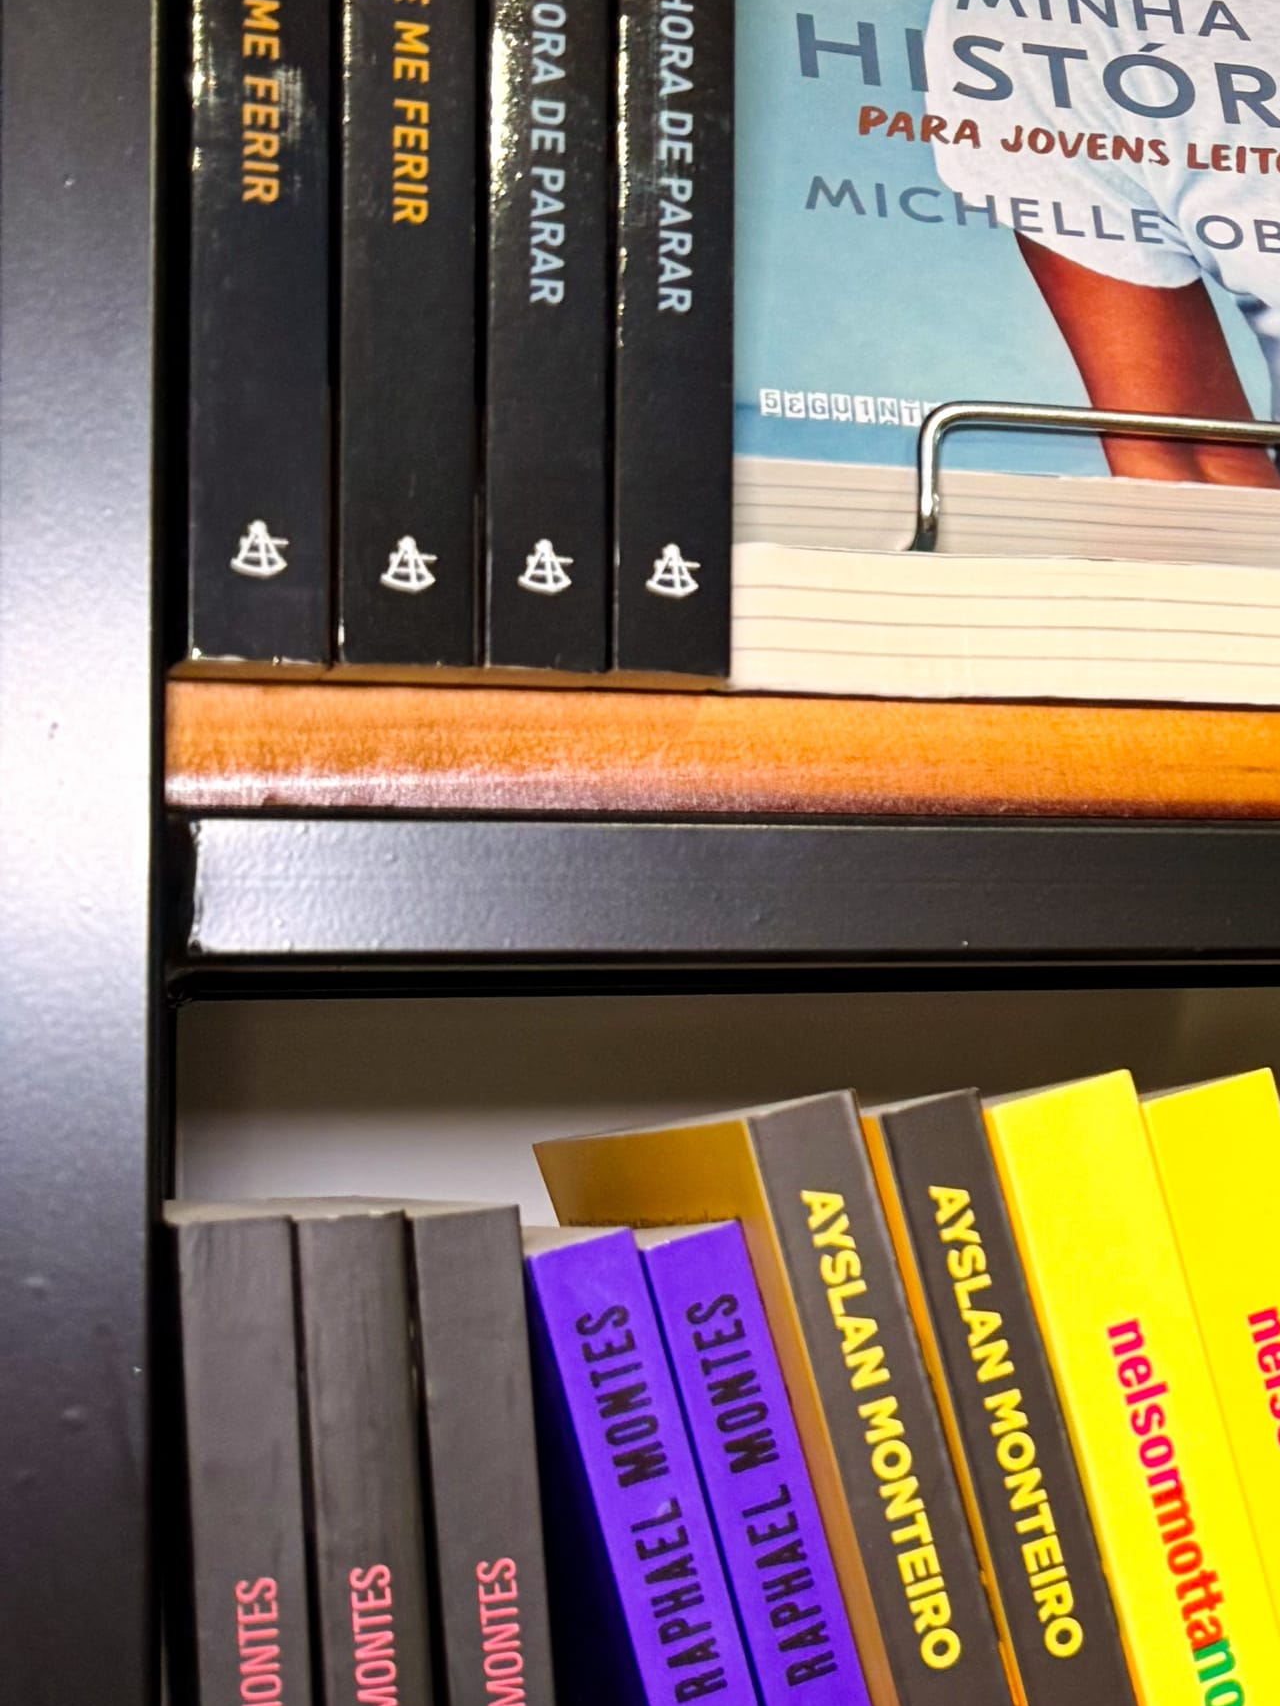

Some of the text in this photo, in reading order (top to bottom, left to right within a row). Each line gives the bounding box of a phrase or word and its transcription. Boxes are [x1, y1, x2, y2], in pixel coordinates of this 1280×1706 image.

[242, 70, 285, 202] FERIR
[530, 98, 564, 152] DE
[857, 104, 982, 150] PARA
[1000, 121, 1171, 169] JOVENS
[530, 167, 564, 303] PARAR
[805, 174, 1165, 247] MICHELLE
[575, 1306, 667, 1487] MONTES
[800, 1190, 960, 1668] AYSLAN MONTEIRO
[631, 1499, 725, 1703] RAPHAEL
